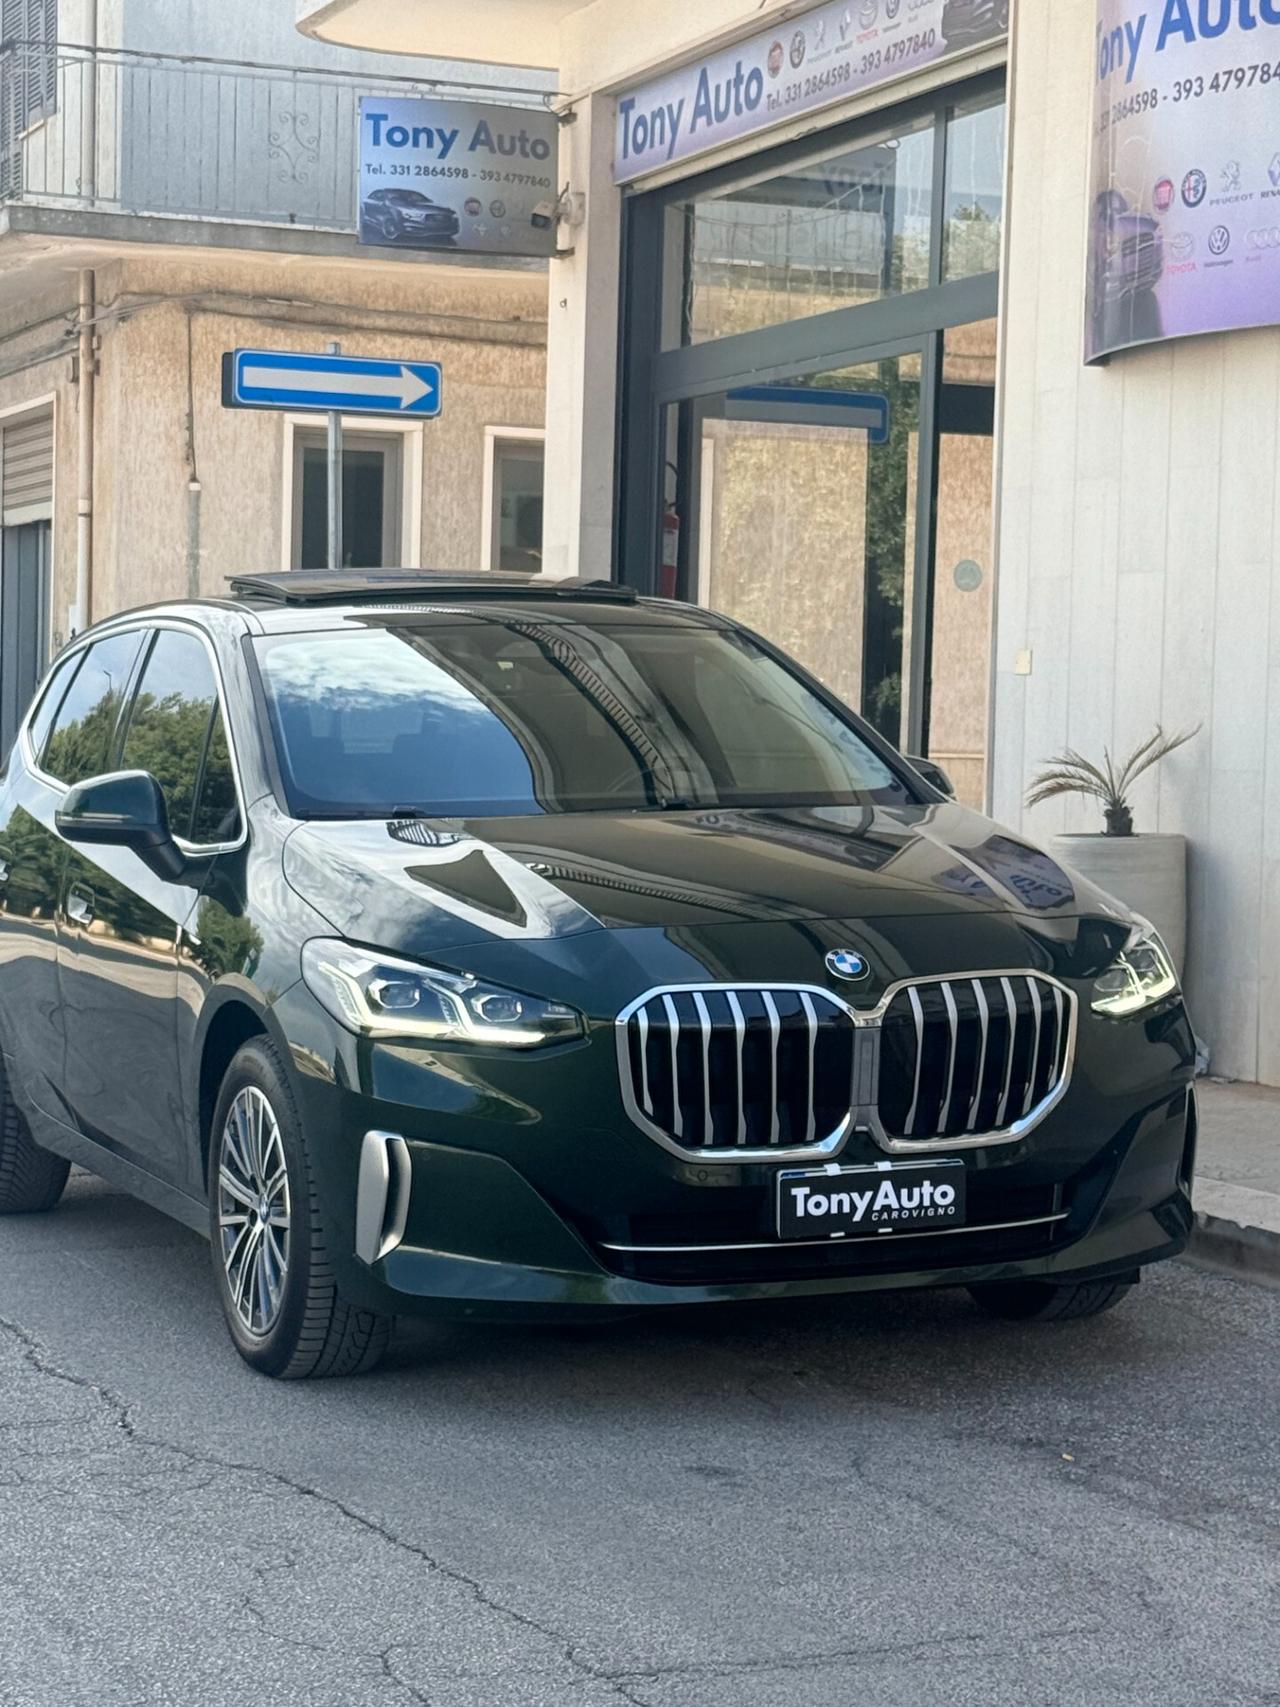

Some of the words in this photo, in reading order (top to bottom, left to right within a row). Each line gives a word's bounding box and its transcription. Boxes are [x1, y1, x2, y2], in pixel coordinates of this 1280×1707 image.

[1155, 0, 1280, 52] Au
[767, 90, 782, 111] Tel.
[785, 81, 802, 105] 331
[804, 62, 850, 97] 2864598
[860, 50, 881, 75] 393
[884, 28, 936, 64] 4797840
[1172, 76, 1204, 103] 393
[619, 97, 684, 160] Tony
[690, 60, 763, 134] Auto
[365, 113, 459, 159] Tony
[468, 119, 550, 160] Auto
[365, 163, 386, 175] Tel.
[390, 165, 411, 176] 331
[414, 165, 469, 179] 2864598
[479, 170, 501, 182] 393
[503, 172, 550, 188] 4797840
[871, 1206, 956, 1221] CAROVIGNO
